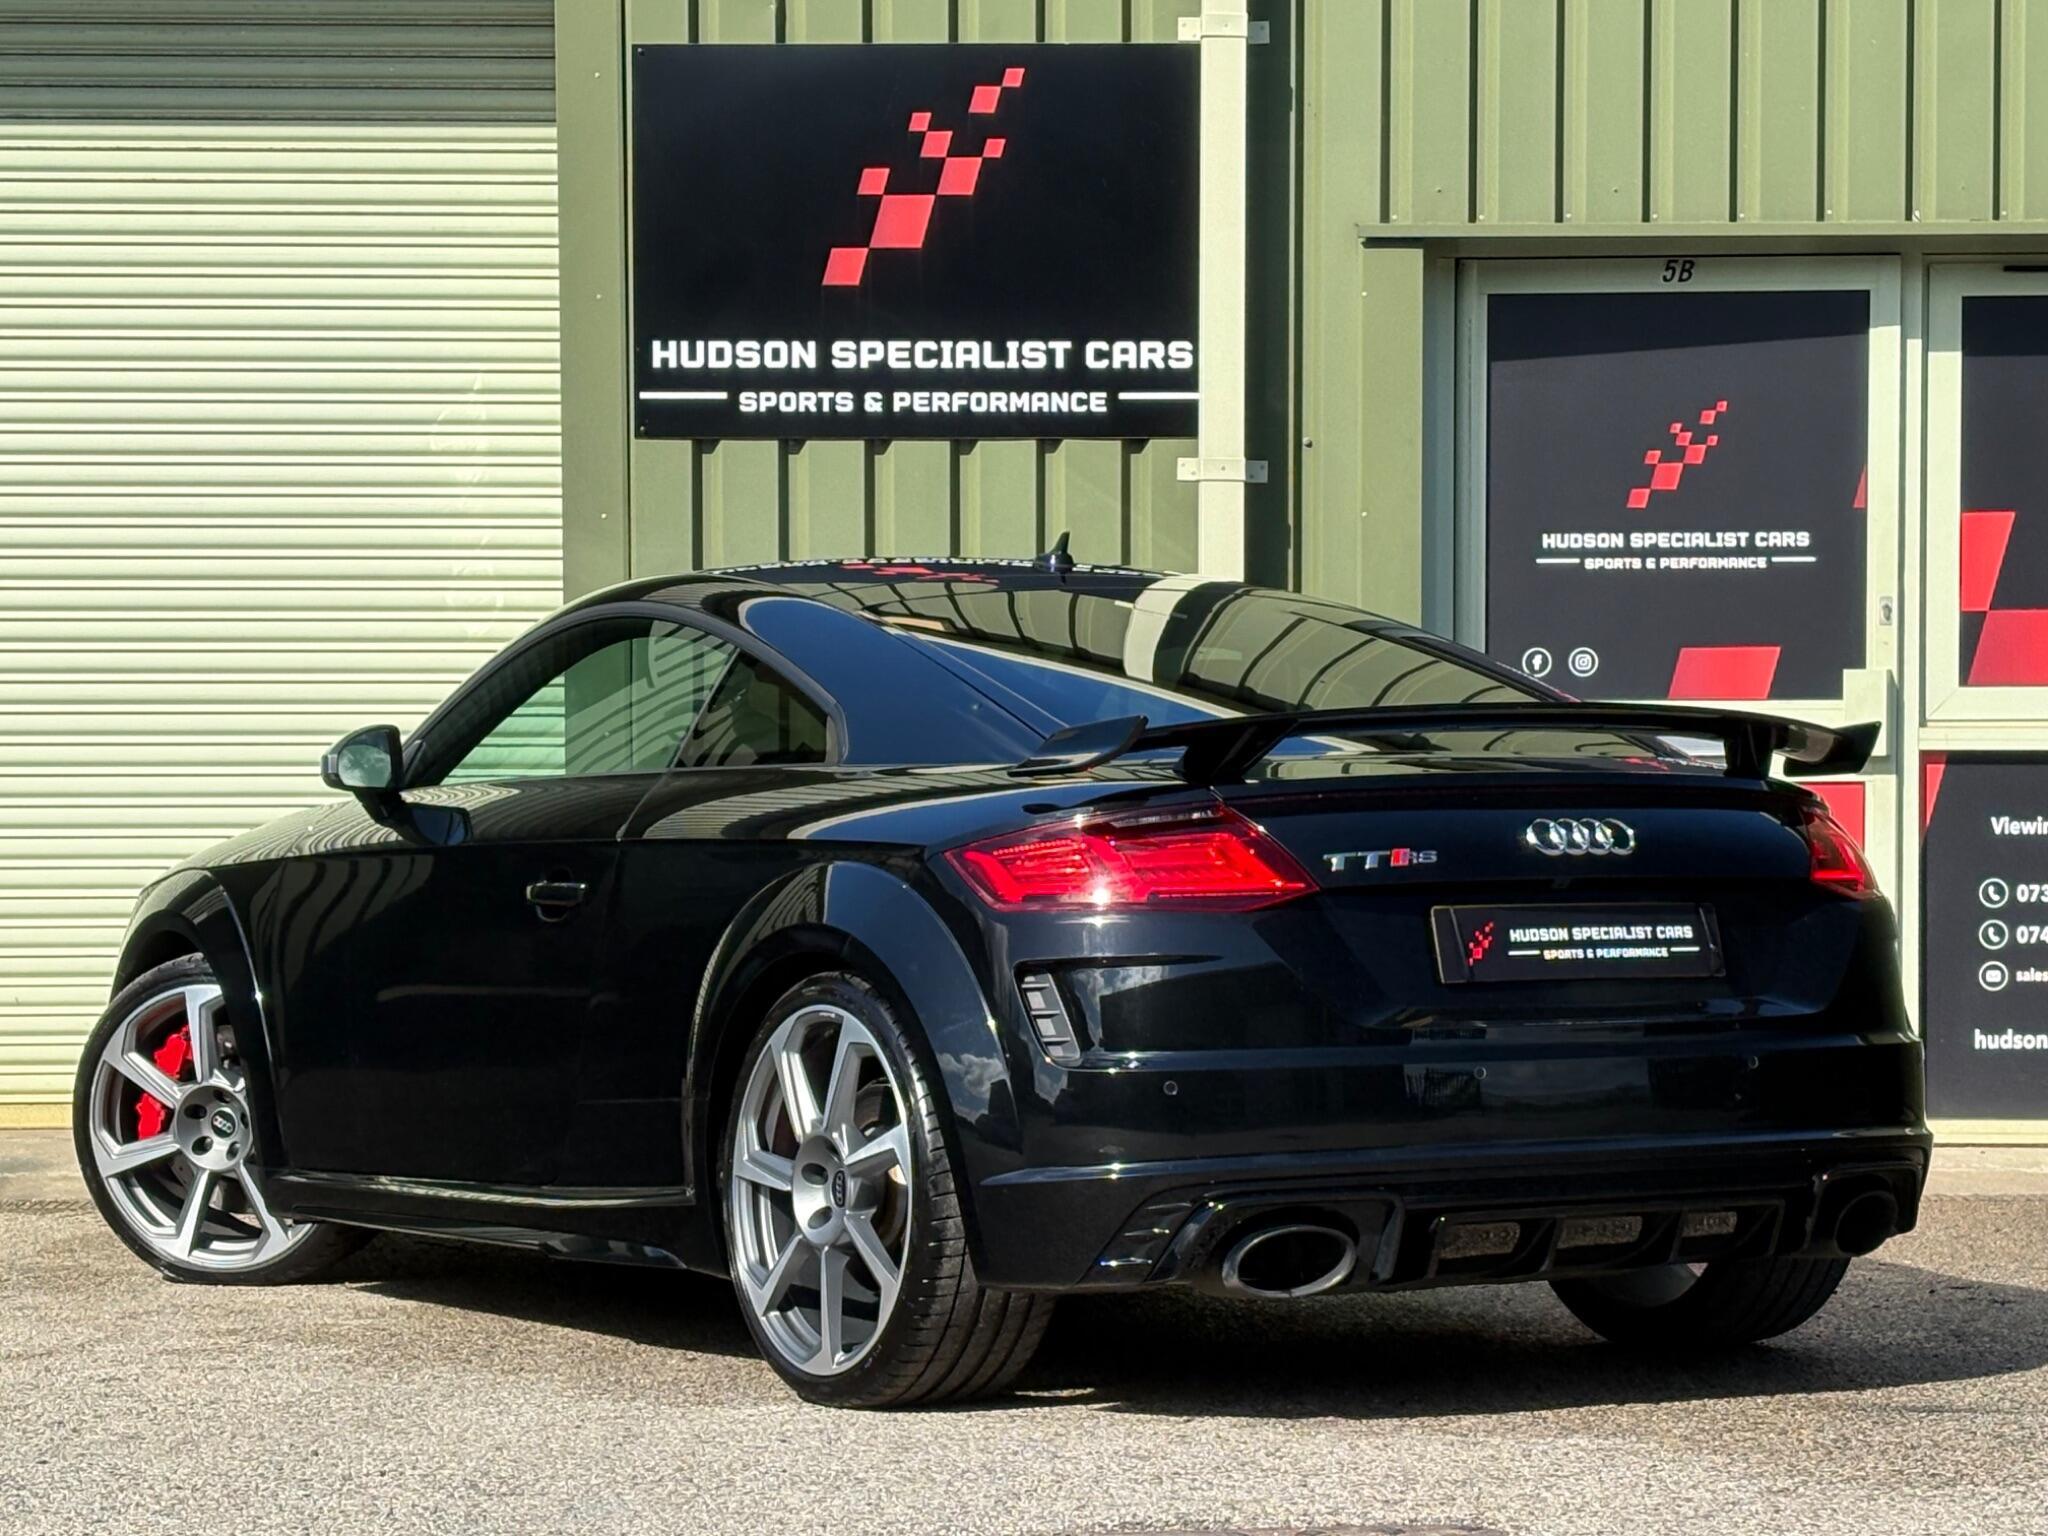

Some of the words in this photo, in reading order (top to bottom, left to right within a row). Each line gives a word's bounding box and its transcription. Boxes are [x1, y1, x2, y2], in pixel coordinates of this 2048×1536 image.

[1662, 259, 1696, 283] 5B
[651, 340, 817, 369] HUDSON
[831, 340, 1073, 369] SPECIALIST
[1085, 340, 1194, 369] CARS
[738, 391, 855, 413] SPORTS
[863, 391, 884, 413] &
[892, 391, 1108, 413] PERFORMANCE
[1541, 532, 1625, 550] HUDSON
[1629, 531, 1750, 549] SPECIALIST
[1754, 530, 1811, 548] CARS
[1583, 557, 1643, 571] SPORTS
[1645, 557, 1657, 571] &
[1659, 556, 1768, 570] PERFORMANCE
[2015, 883, 2048, 903] 073
[1509, 927, 1570, 943] HUDSON
[1571, 926, 1653, 941] SPECIALIST
[1655, 925, 1694, 940] CARS
[2015, 924, 2048, 945] 074
[1542, 949, 1585, 961] SPORTS
[1596, 947, 1669, 960] PERFORMANCE
[1974, 1028, 2048, 1050] hudson
